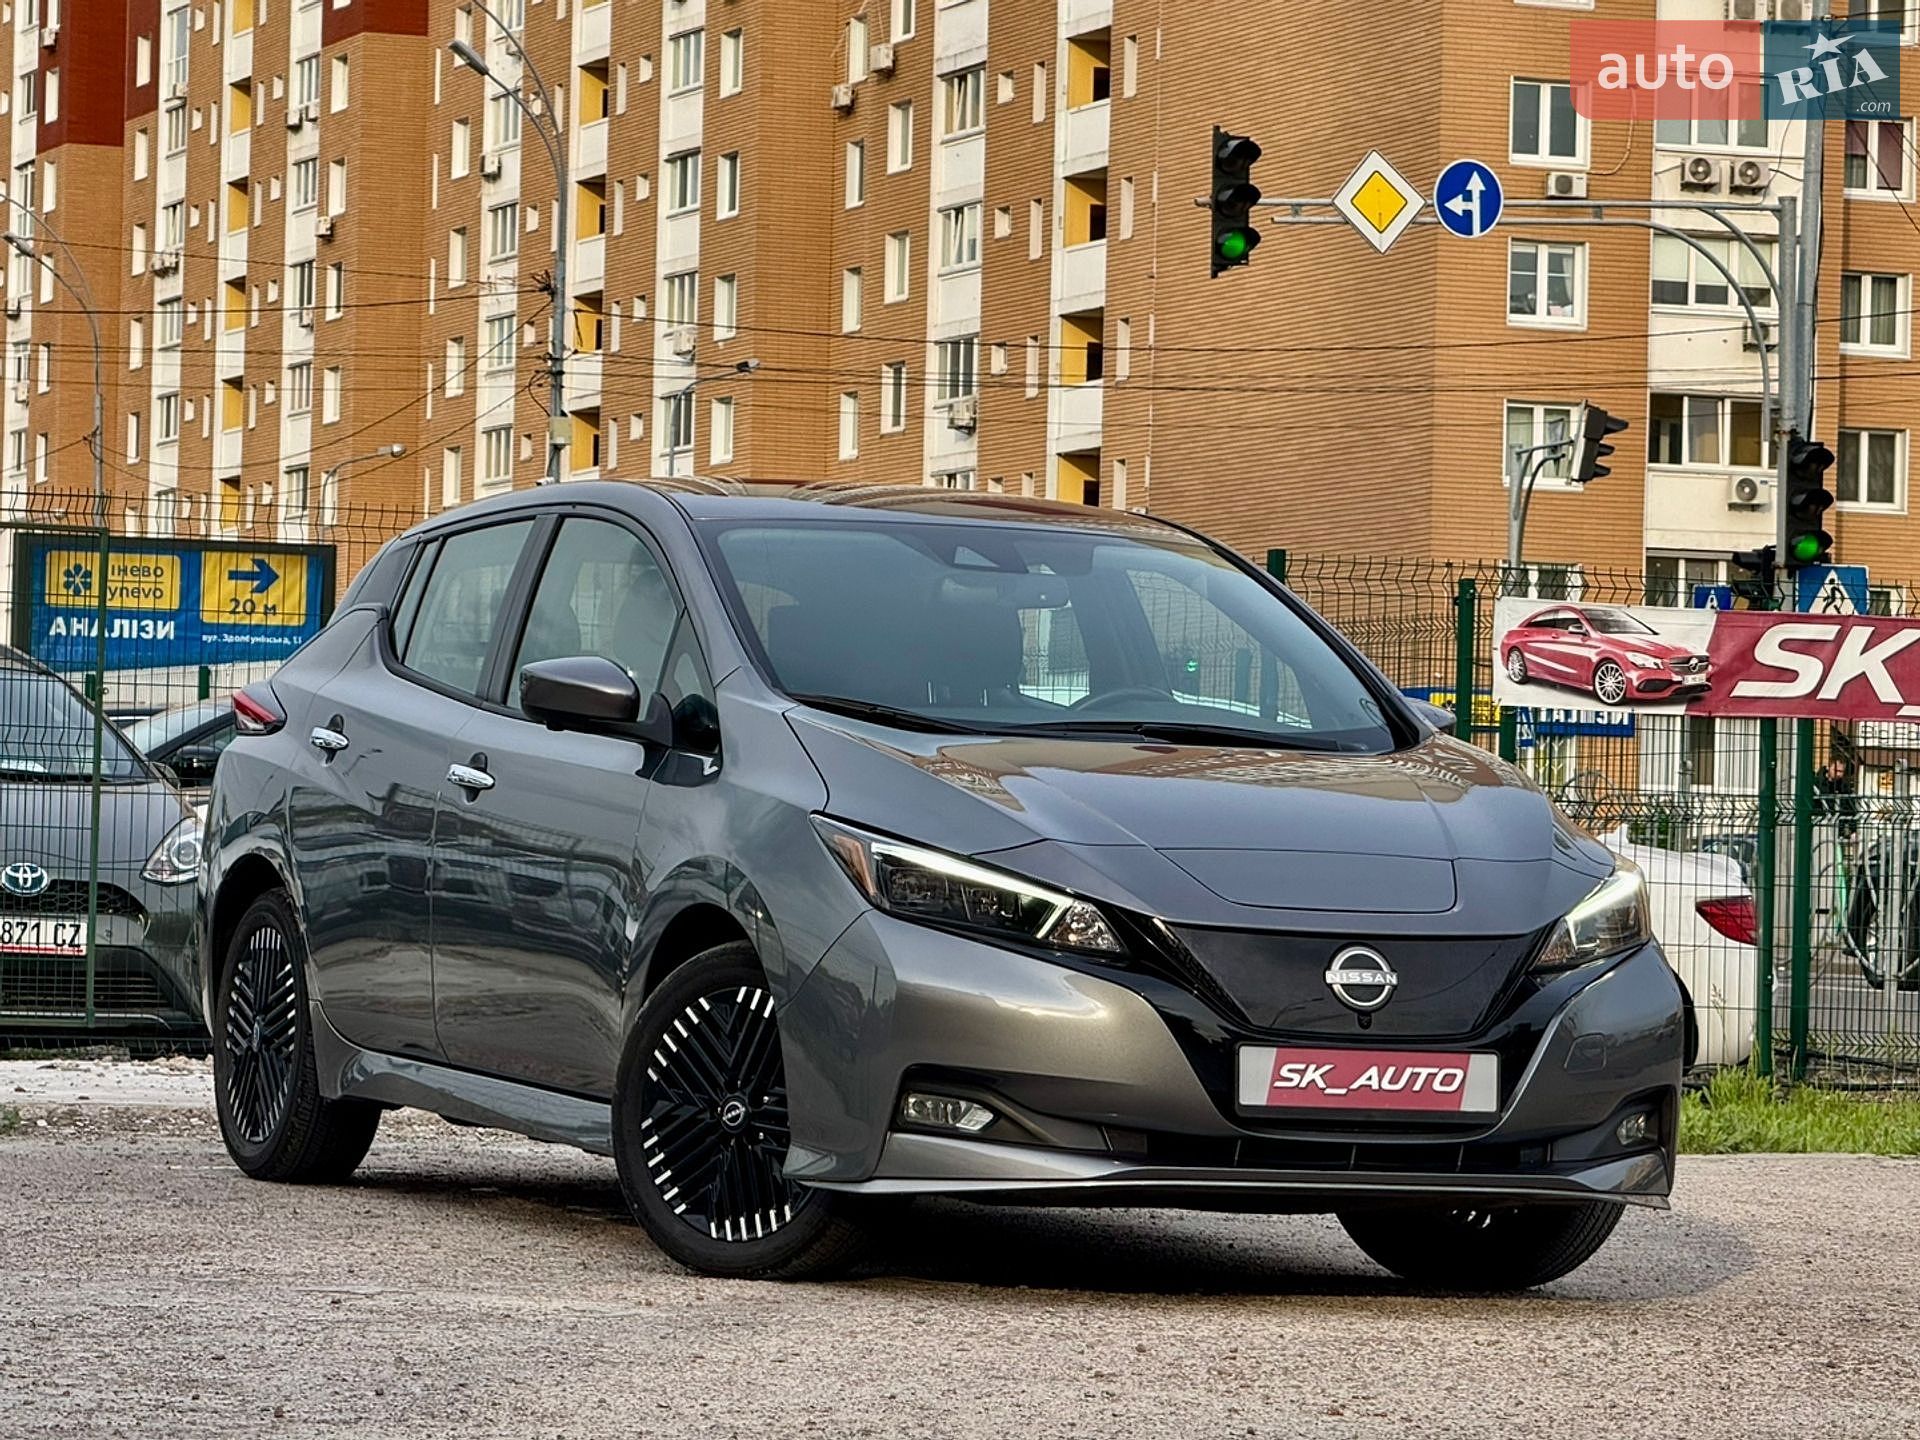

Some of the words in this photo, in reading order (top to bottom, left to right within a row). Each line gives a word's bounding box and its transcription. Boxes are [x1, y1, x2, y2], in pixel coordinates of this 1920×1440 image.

[111, 563, 164, 578] інево
[108, 585, 164, 601] ynevo
[229, 597, 256, 615] 20
[49, 616, 175, 640] АНАЛІЗИ
[54, 922, 82, 947] CZ
[1326, 971, 1398, 985] NISSAN
[1273, 1063, 1465, 1095] SK_AUTO
